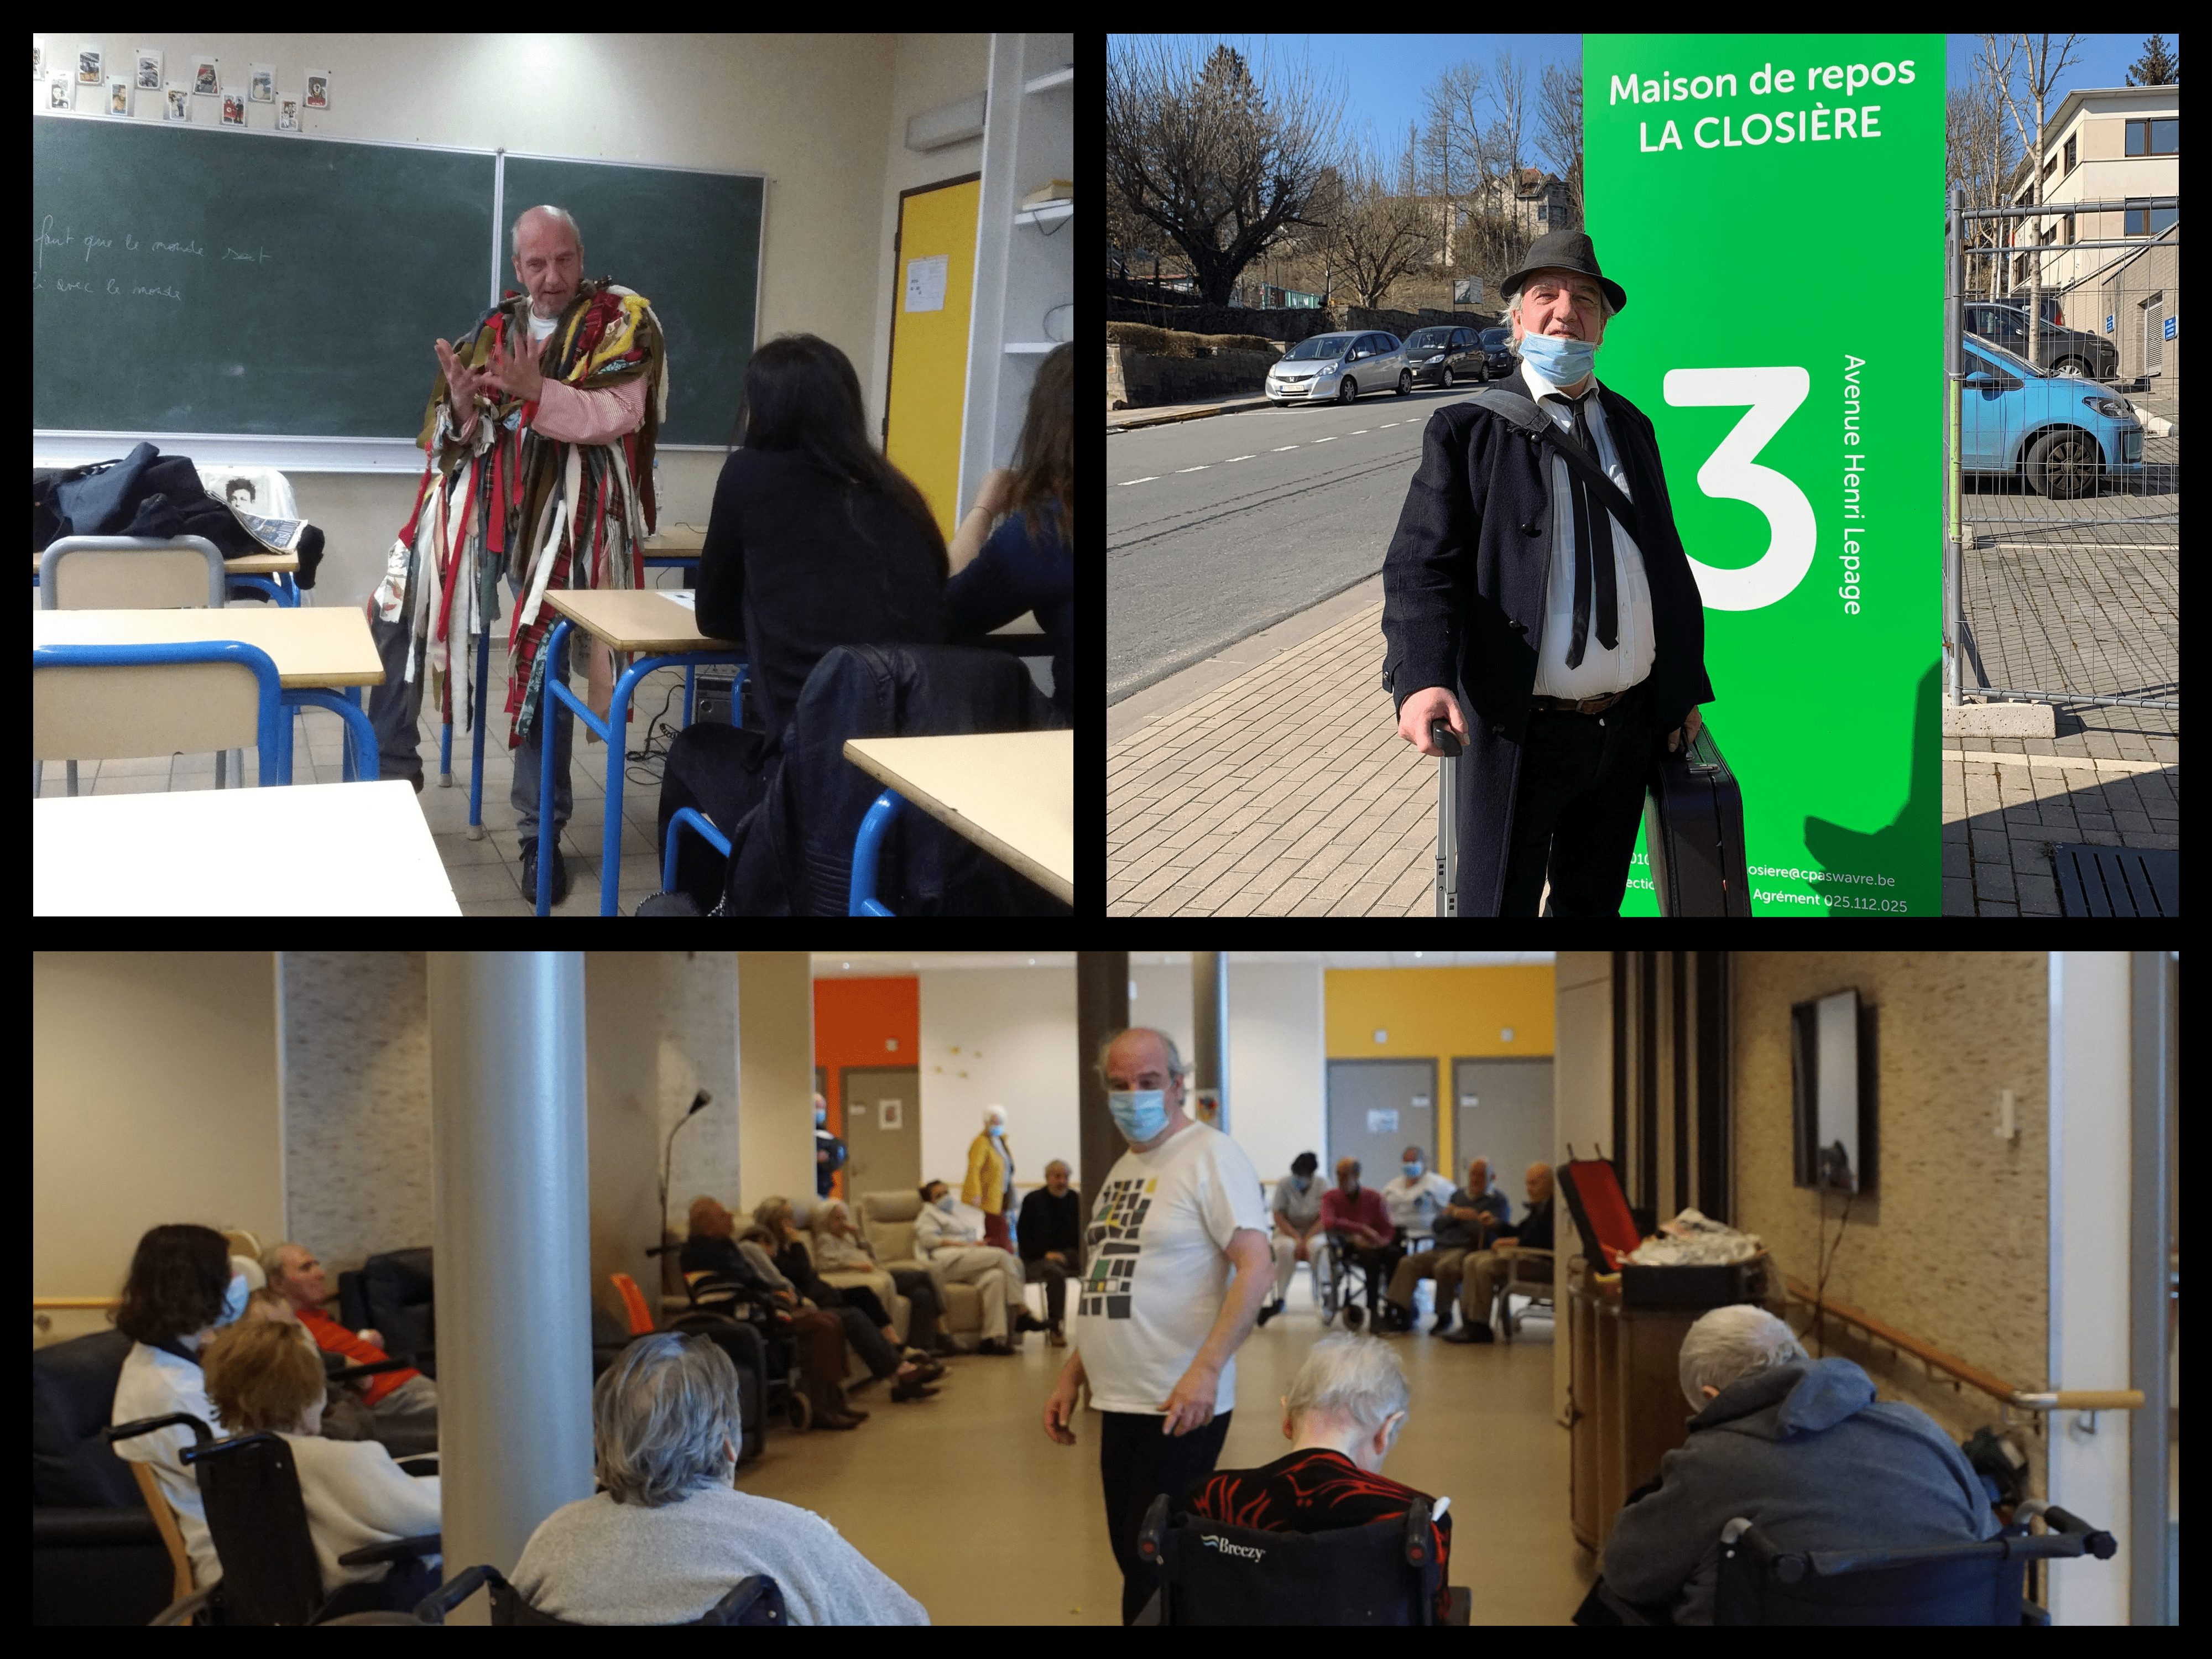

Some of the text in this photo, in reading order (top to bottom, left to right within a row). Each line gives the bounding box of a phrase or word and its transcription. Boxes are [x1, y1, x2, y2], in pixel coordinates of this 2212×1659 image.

[1610, 60, 1916, 106] Maison de repos
[1640, 102, 1881, 153] LA CLOSIÈRE
[84, 236, 112, 262] que
[126, 234, 139, 251] le
[152, 240, 204, 257] monde
[107, 278, 121, 295] le
[132, 285, 182, 301] monde
[1663, 366, 1817, 612] 3
[1839, 354, 1866, 615] Avenue Henri Lepage
[1752, 888, 1908, 913] Agrément 025.112.025
[1219, 1537, 1262, 1562] Breezy
